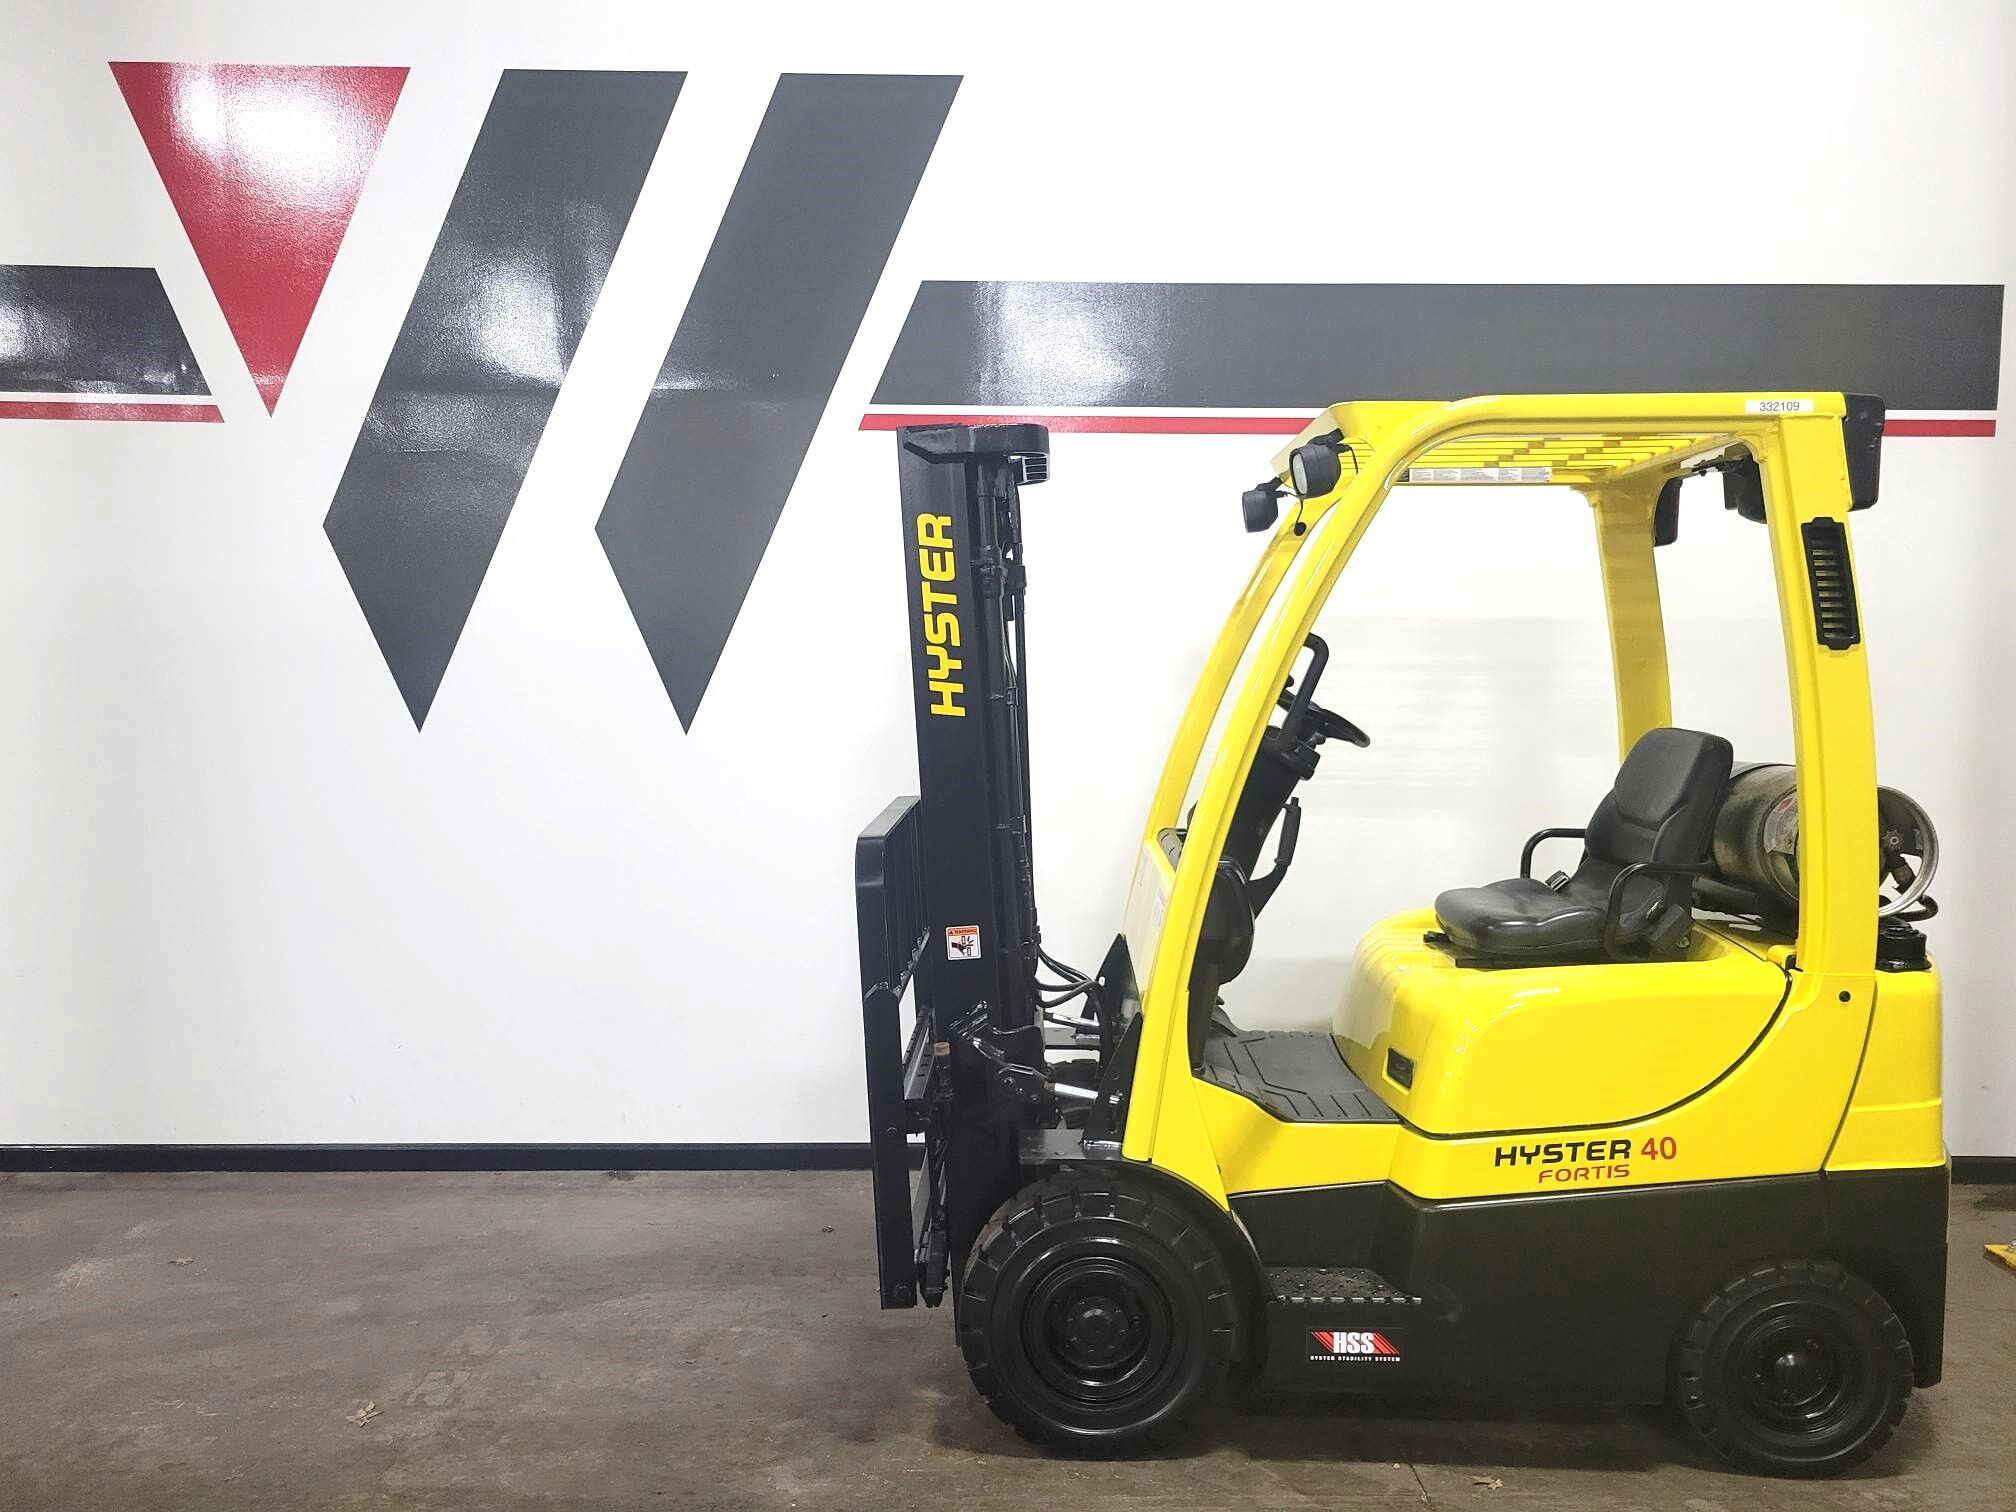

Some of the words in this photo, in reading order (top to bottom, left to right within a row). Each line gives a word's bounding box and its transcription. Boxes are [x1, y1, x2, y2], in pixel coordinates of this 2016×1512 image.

[1759, 401, 1800, 412] 332109
[916, 513, 966, 717] HYSTER
[1494, 1139, 1632, 1167] HYSTER
[1640, 1136, 1677, 1161] 40
[1538, 1164, 1630, 1184] FORTIS
[1333, 1331, 1375, 1354] HSS
